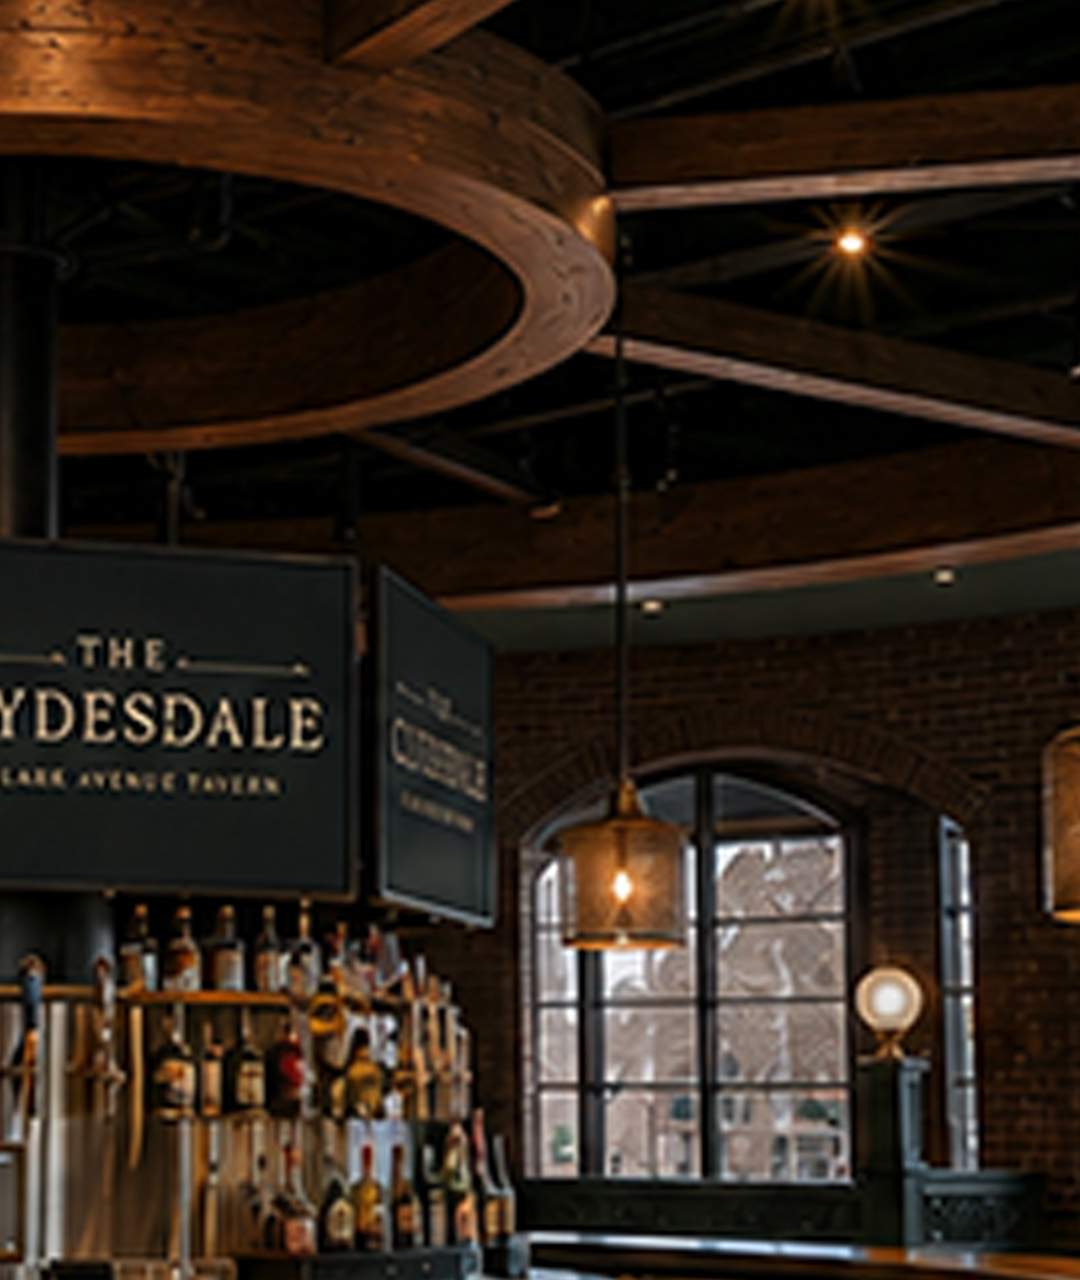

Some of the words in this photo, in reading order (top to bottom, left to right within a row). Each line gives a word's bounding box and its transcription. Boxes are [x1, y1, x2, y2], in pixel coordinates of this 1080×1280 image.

[76, 634, 166, 672] THE
[78, 770, 177, 793] AVENUE
[186, 772, 281, 796] TAVERN
